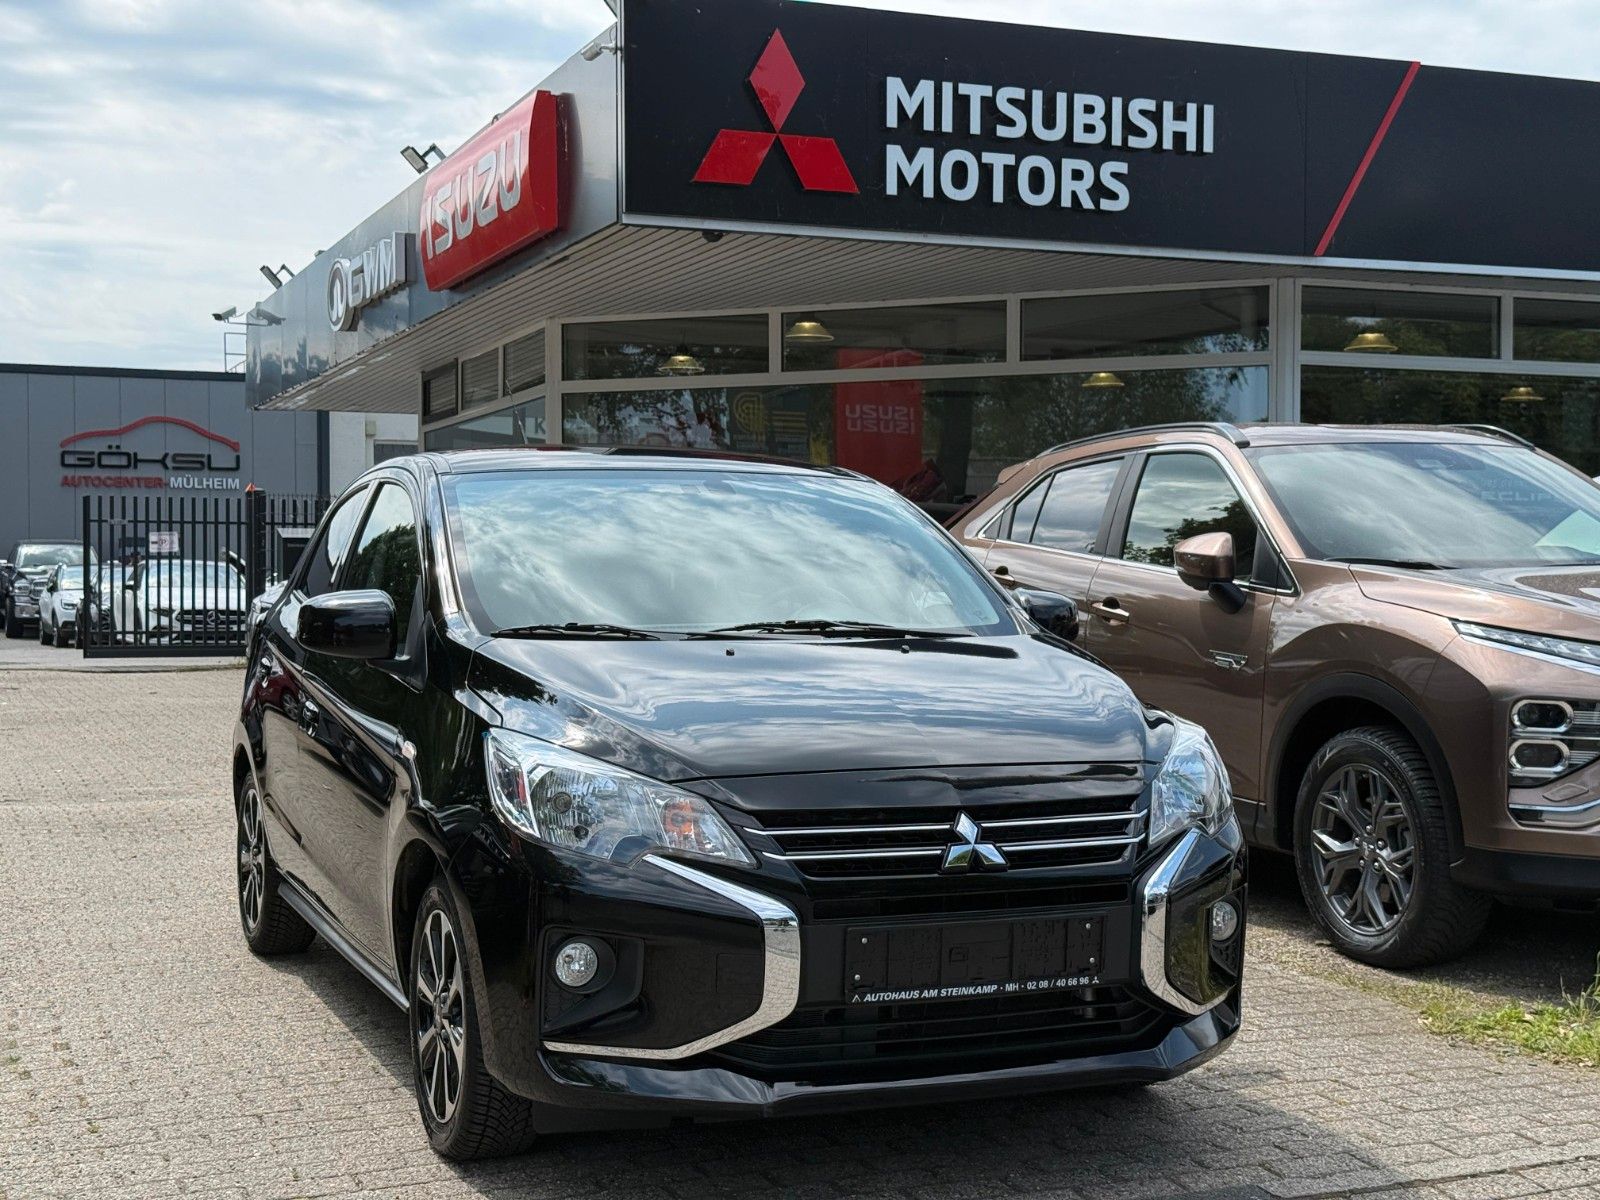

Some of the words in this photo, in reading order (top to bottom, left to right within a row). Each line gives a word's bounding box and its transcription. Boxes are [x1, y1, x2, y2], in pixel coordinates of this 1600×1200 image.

[886, 76, 1214, 153] MITSUBISHI
[425, 131, 521, 260] ISUZU
[886, 144, 1130, 211] MOTORS
[347, 231, 397, 308] GWM
[61, 445, 240, 472] GÖKSU
[863, 990, 920, 1002] AUTOHAUS
[921, 989, 938, 999] AM
[940, 984, 998, 997] STEINKAMP
[1005, 982, 1019, 992] MH
[1026, 981, 1037, 990] 02
[1038, 980, 1048, 989] 08
[1056, 978, 1066, 987] 40
[1067, 977, 1077, 986] 66
[1079, 976, 1089, 985] 96
